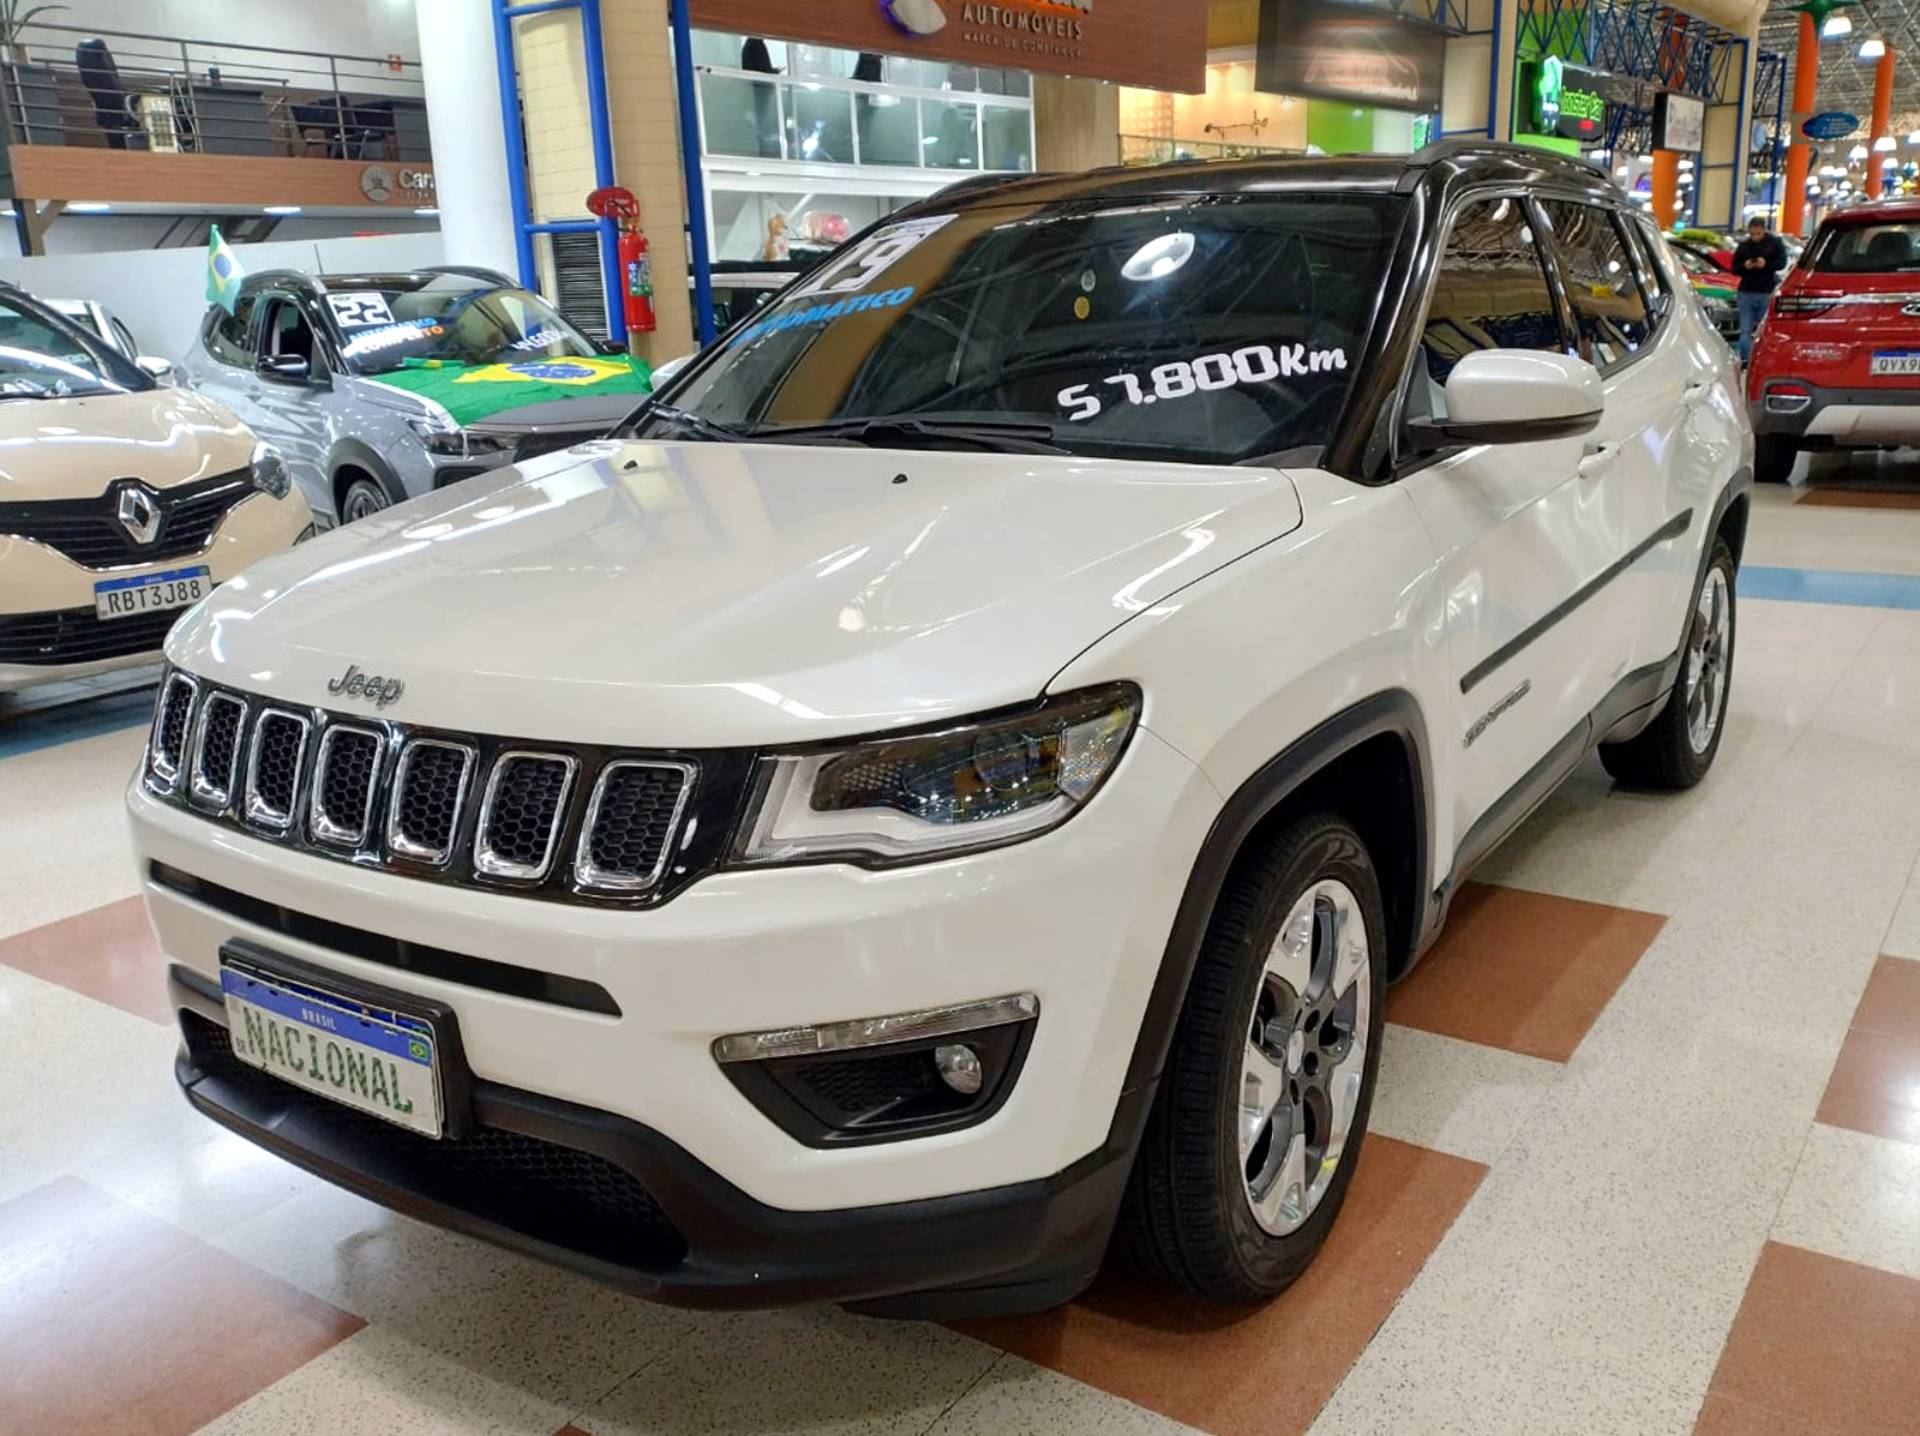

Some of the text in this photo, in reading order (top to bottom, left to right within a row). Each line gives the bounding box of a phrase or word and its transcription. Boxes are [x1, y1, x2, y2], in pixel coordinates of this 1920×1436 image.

[963, 4, 1083, 41] AUTOMÓVEIS
[337, 300, 391, 325] 22
[1879, 358, 1920, 371] QYX9
[108, 580, 201, 613] RBT3J88
[328, 664, 404, 708] Jeep
[302, 1008, 337, 1031] BRASIL
[243, 1006, 413, 1114] NACIONAL
